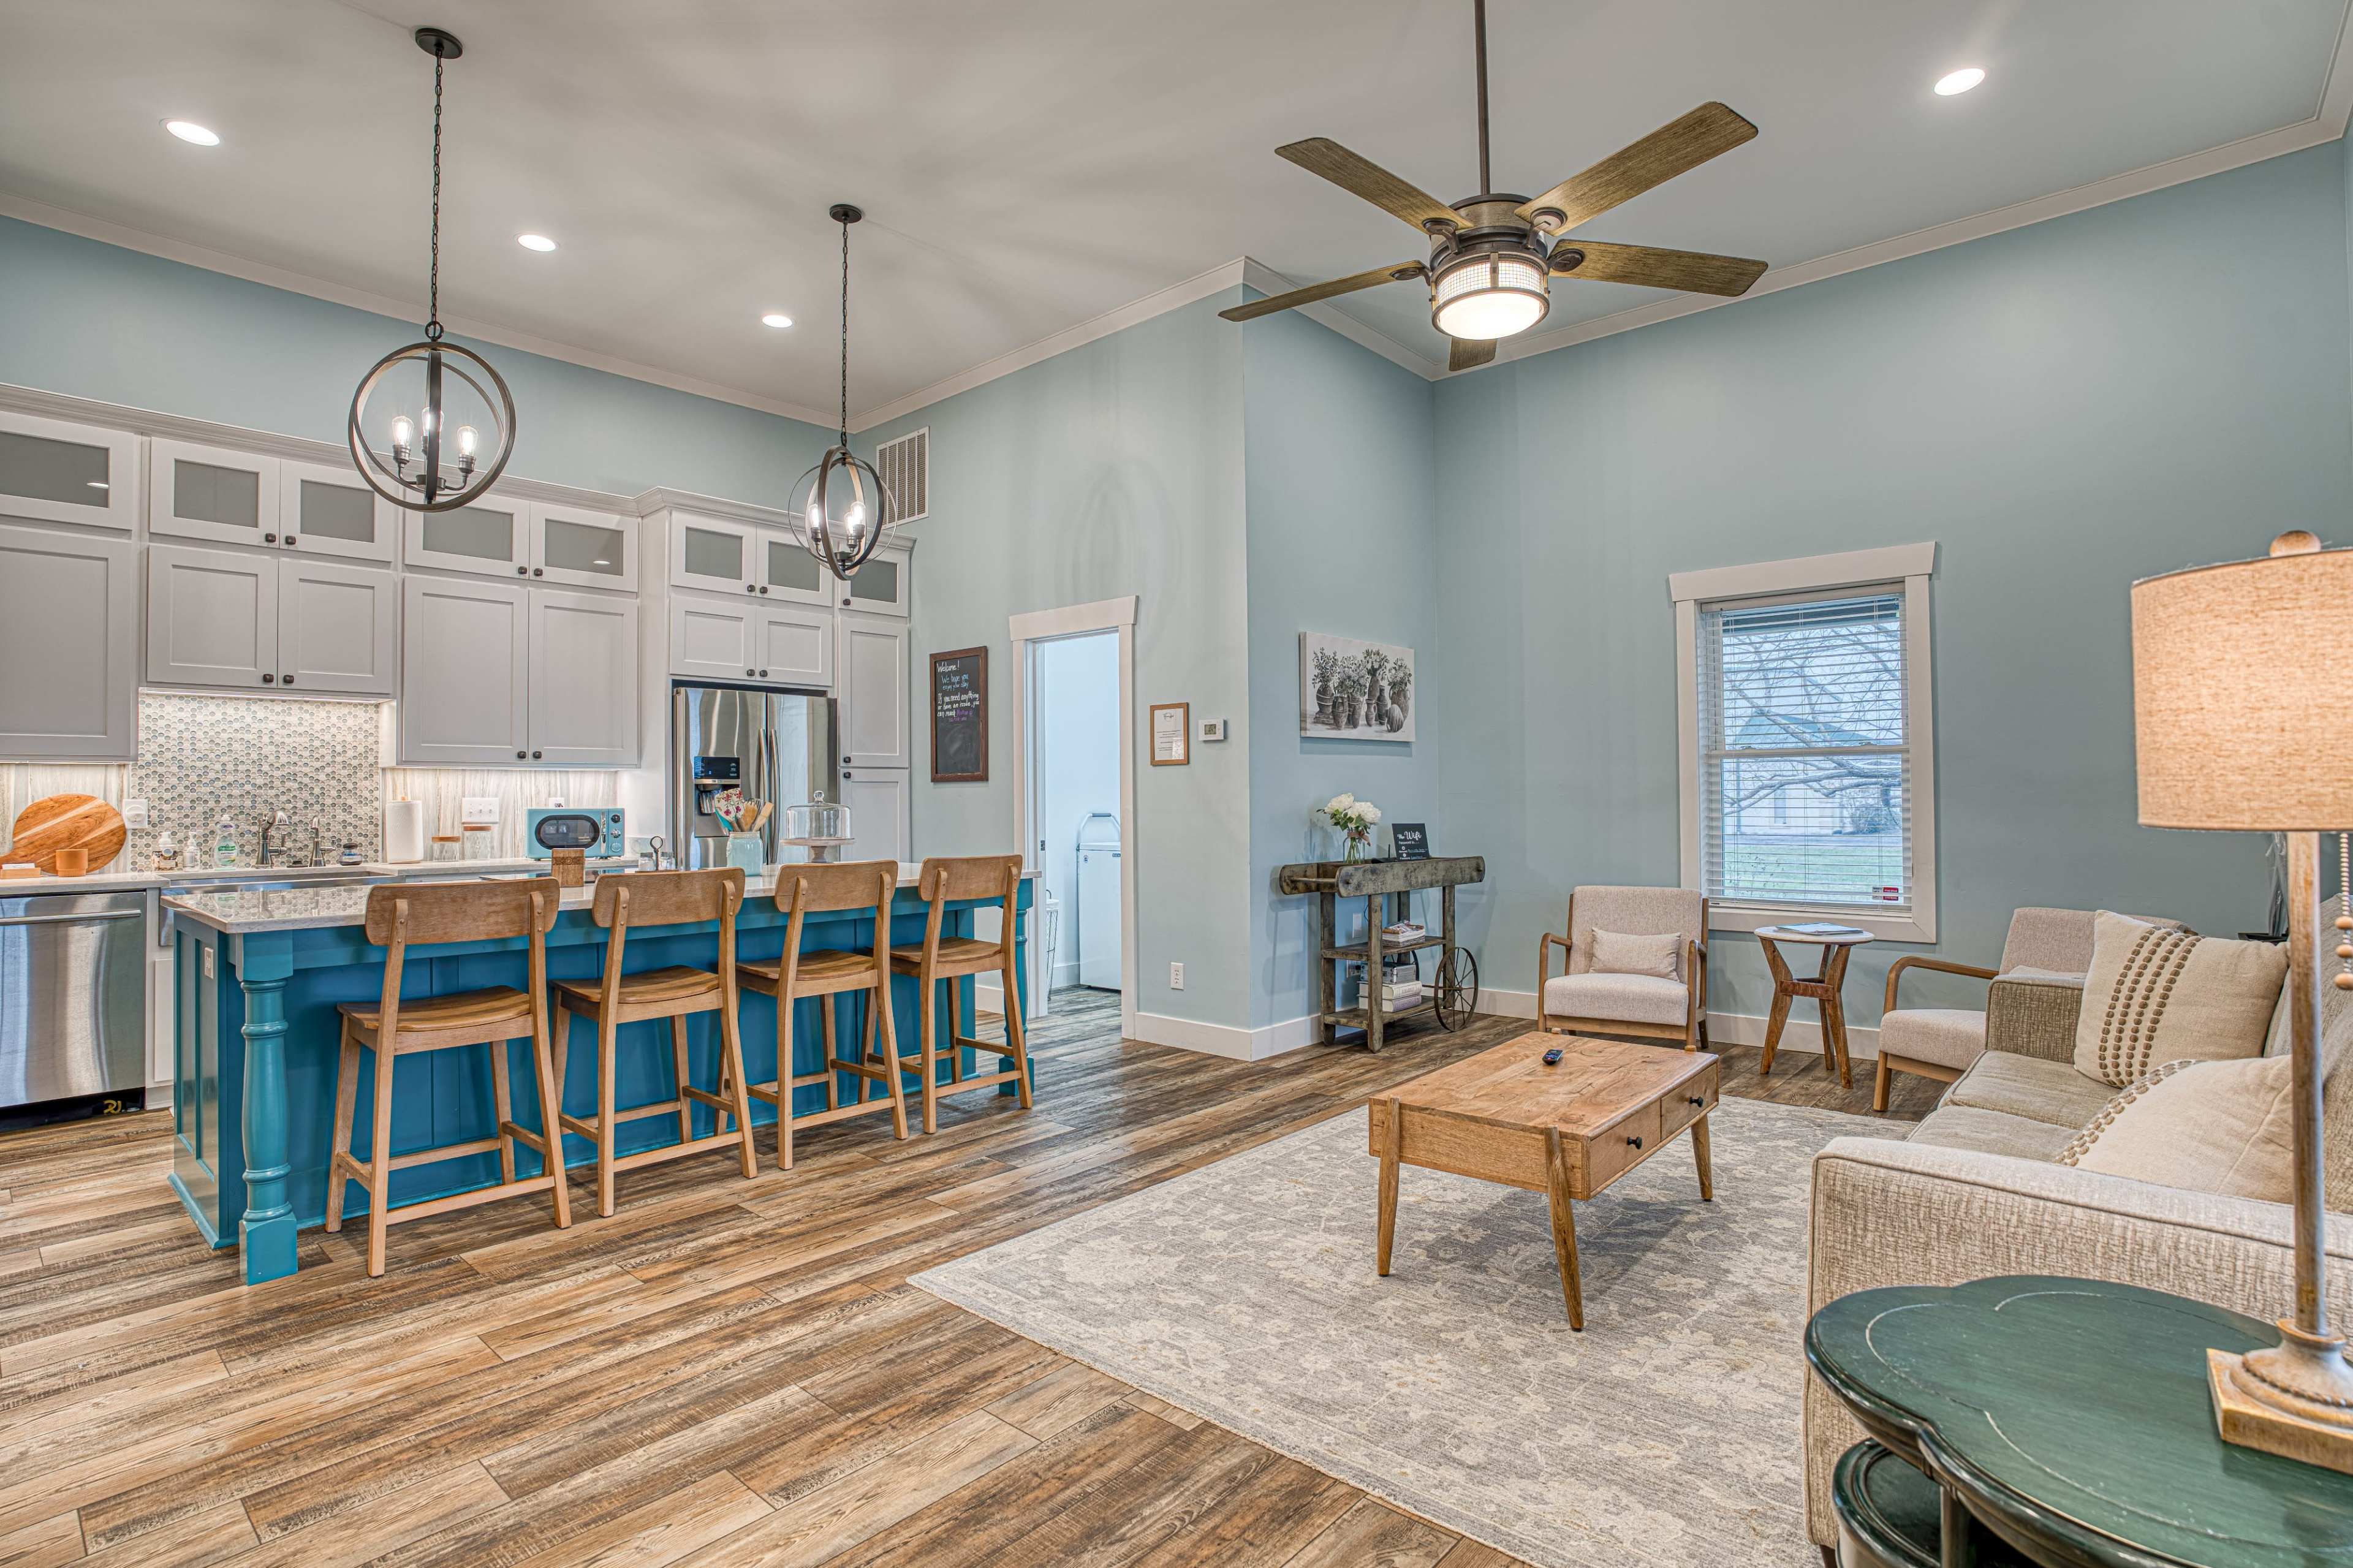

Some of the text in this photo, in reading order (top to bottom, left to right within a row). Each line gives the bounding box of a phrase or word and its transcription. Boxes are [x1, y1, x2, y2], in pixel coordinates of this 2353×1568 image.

[941, 674, 950, 684] We
[950, 673, 960, 683] hope
[938, 692, 942, 705] If
[950, 692, 960, 702] need
[961, 690, 979, 703] anything
